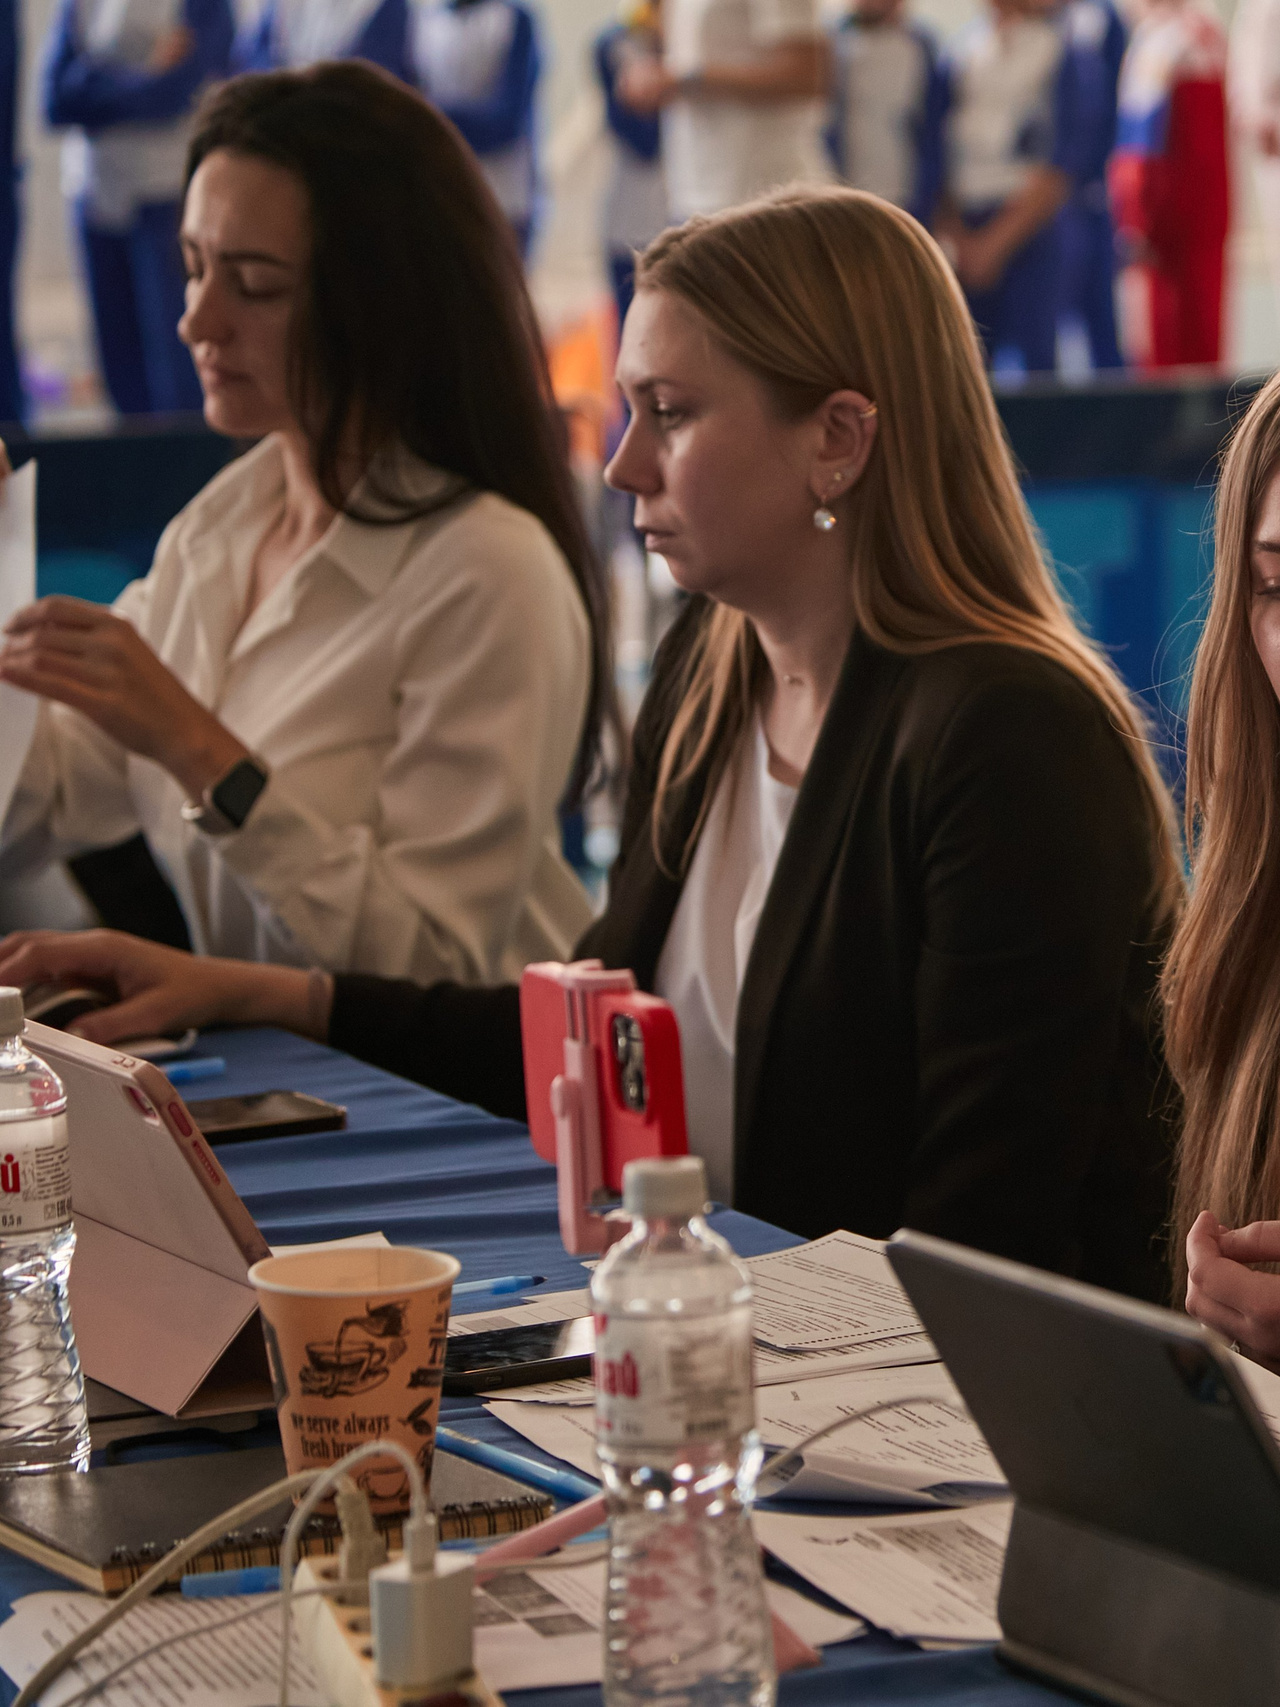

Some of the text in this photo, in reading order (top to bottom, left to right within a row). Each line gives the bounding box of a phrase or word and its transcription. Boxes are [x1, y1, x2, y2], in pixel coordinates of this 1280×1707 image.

[307, 1416, 340, 1434] serve
[344, 1412, 390, 1441] always
[301, 1436, 329, 1459] fresh
